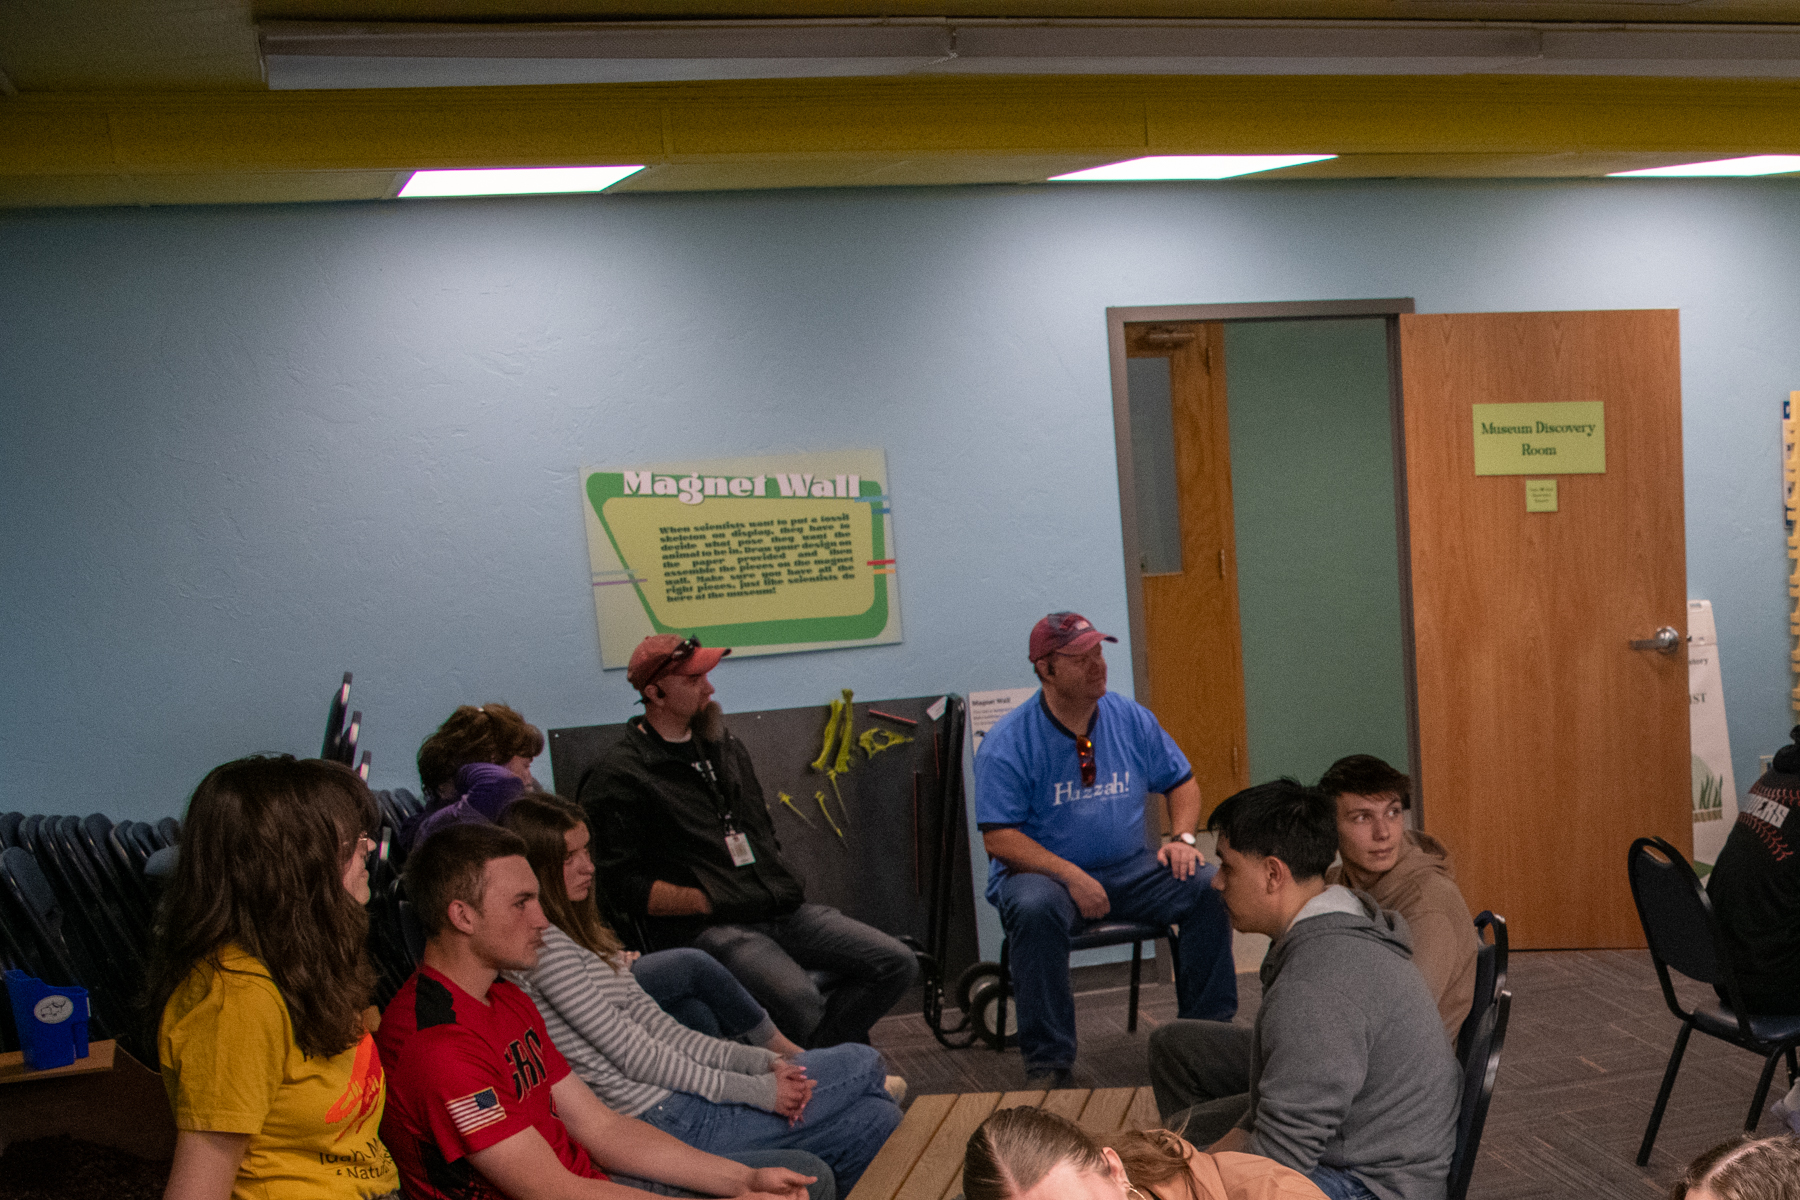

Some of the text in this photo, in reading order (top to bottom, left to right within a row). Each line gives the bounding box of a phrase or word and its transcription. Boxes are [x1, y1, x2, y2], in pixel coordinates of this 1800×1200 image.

[1481, 421, 1596, 436] Museum Discovery
[1522, 444, 1557, 456] Room
[623, 470, 860, 505] Magnet Wall
